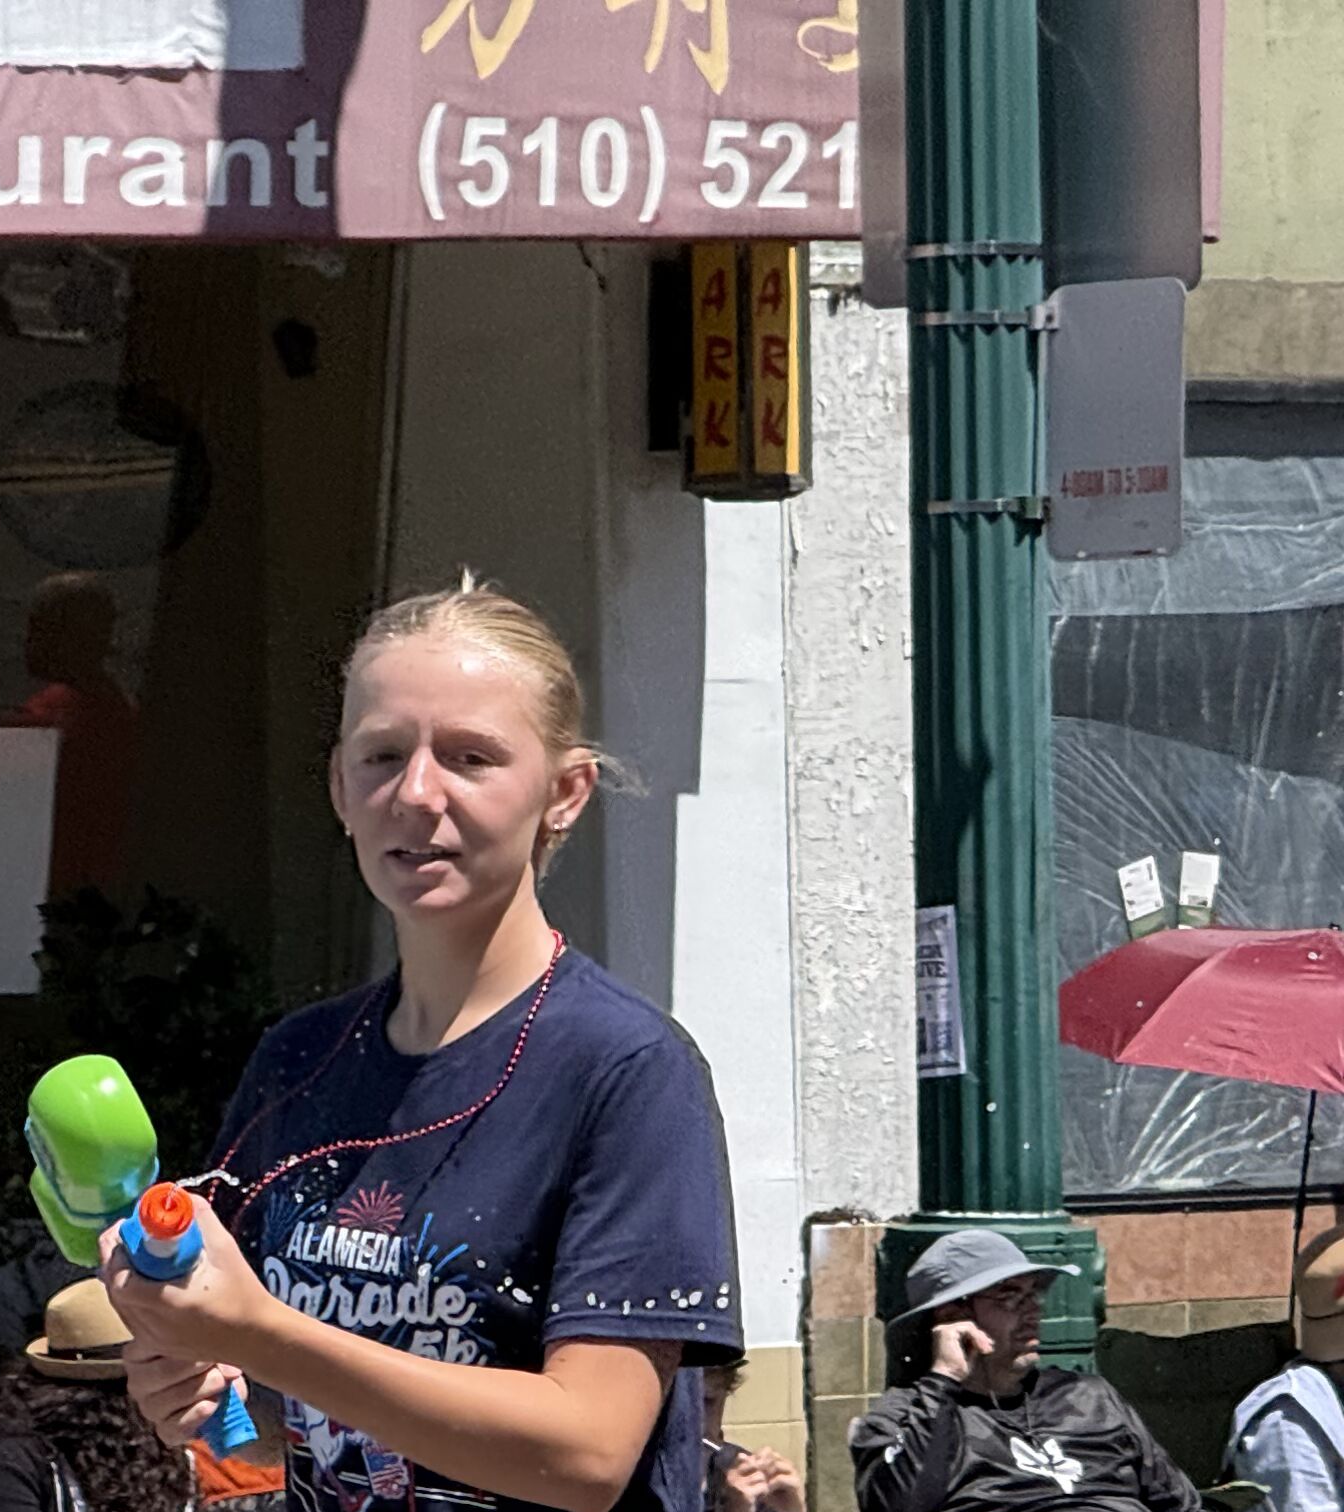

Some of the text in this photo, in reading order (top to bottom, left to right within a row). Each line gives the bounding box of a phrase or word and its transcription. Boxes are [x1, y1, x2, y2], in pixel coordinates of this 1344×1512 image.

[418, 98, 666, 224] (510)
[700, 266, 733, 449] ARK
[755, 266, 788, 448] ARK
[286, 1220, 403, 1276] ALAMEDA
